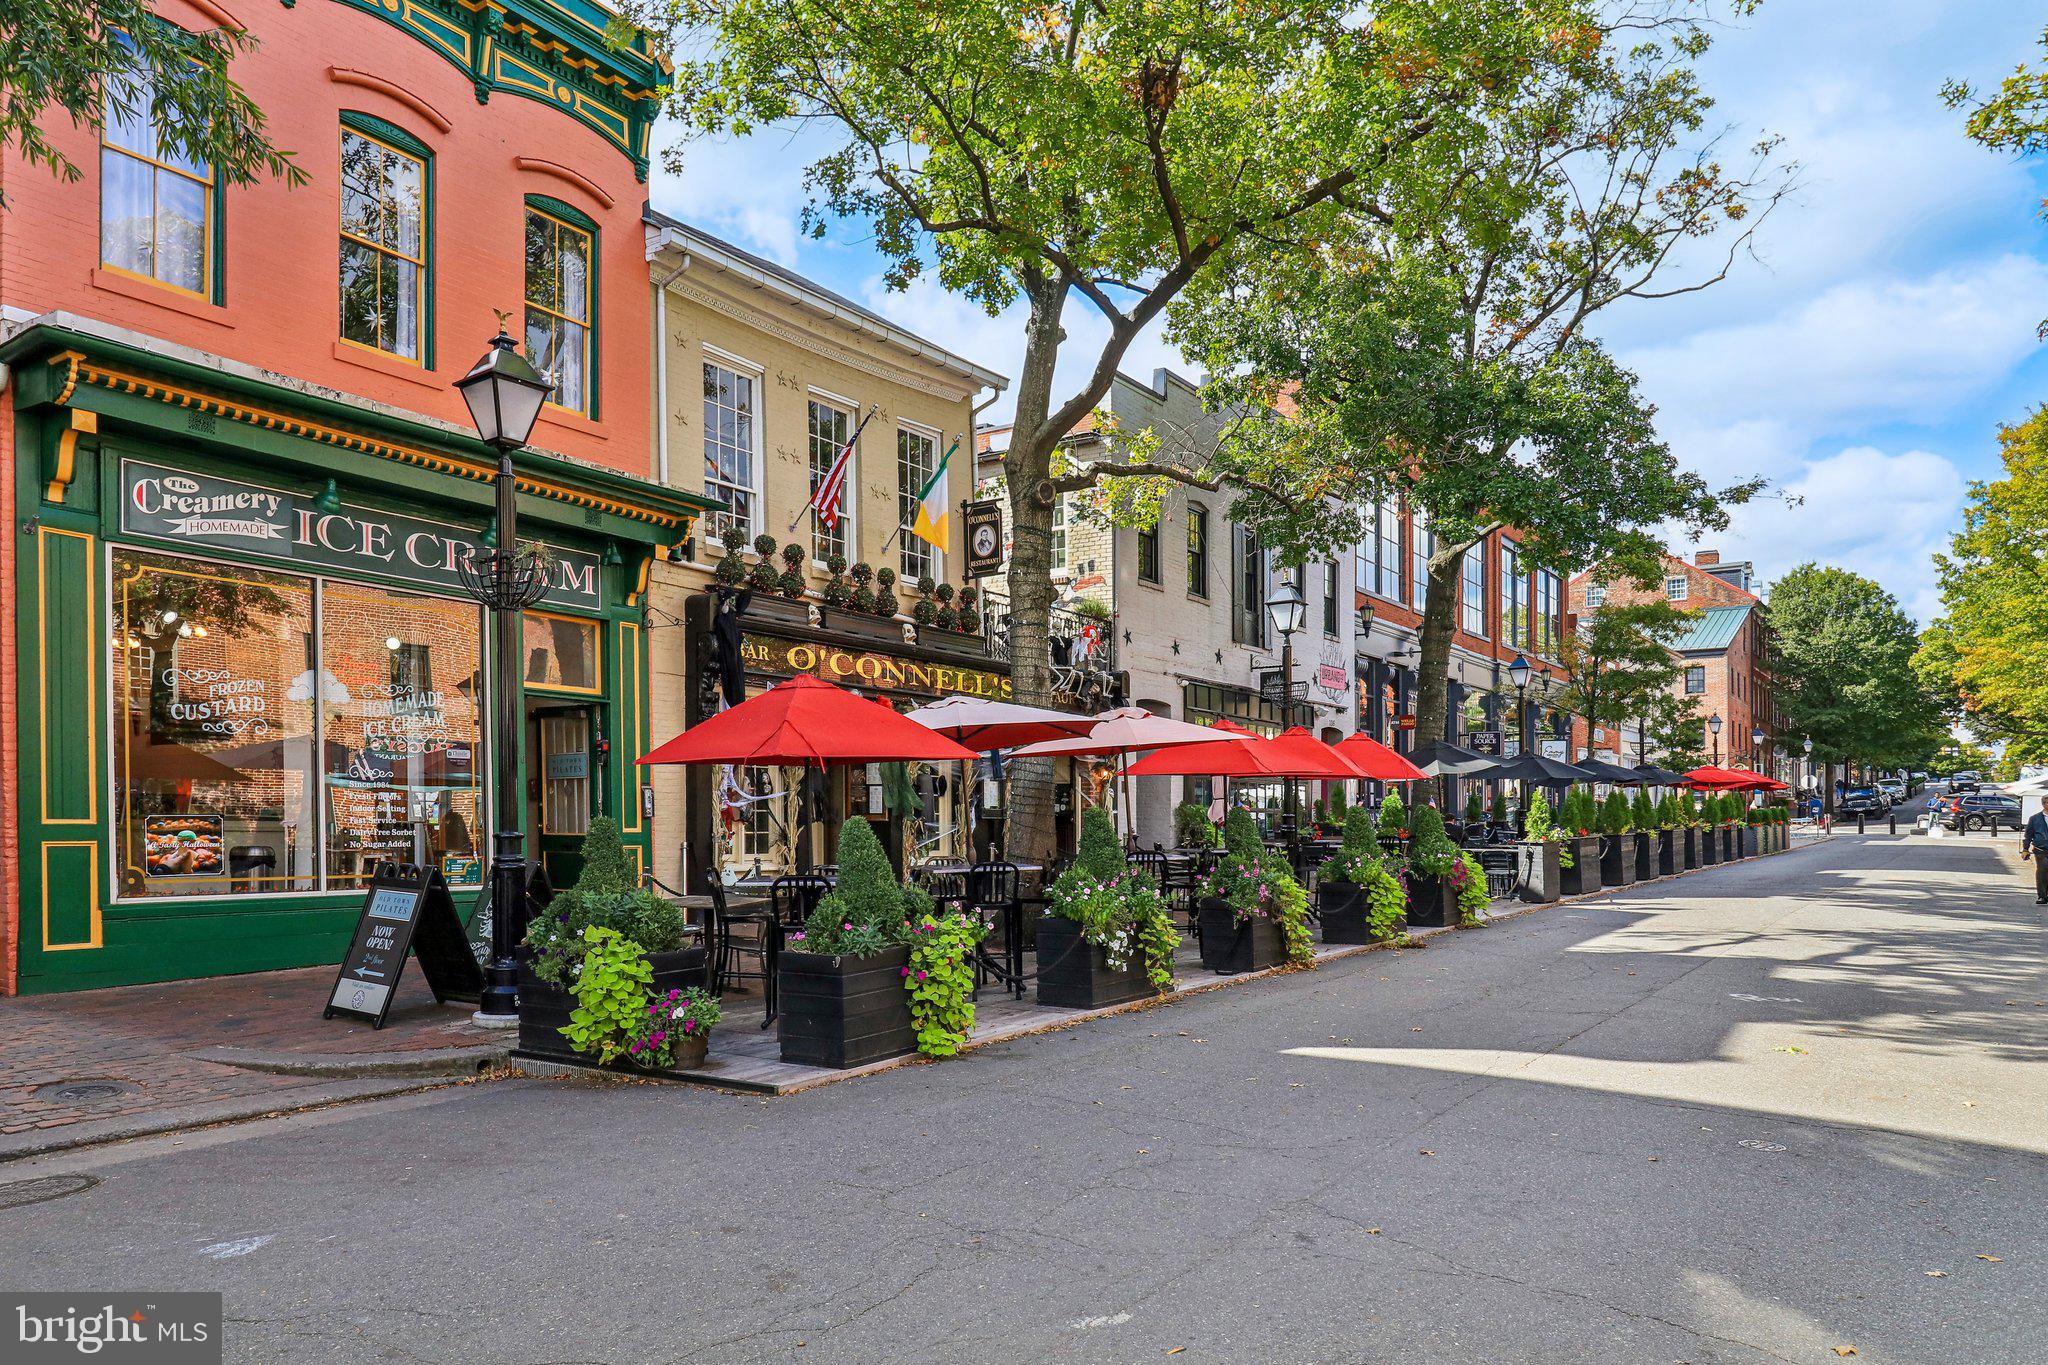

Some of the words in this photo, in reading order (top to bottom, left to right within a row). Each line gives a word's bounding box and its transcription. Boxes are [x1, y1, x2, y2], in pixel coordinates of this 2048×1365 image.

[168, 478, 196, 490] The
[132, 478, 282, 517] Creamery
[190, 521, 266, 535] HOMEMADE
[292, 508, 395, 562] ICE
[405, 532, 597, 596] CRAM
[787, 646, 1013, 699] O'CONNELL'S
[209, 680, 265, 697] FROZEN
[170, 696, 266, 720] CUSTARD
[363, 690, 445, 716] HOMEMADE
[363, 721, 387, 738] ICE
[391, 710, 446, 733] CREAM
[552, 765, 582, 774] PILATES
[377, 805, 406, 813] Seating
[391, 828, 417, 836] Sorbet
[182, 840, 221, 848] Halloween
[362, 841, 386, 849] Sugar
[387, 840, 411, 848] Added
[375, 903, 408, 915] PILATES
[371, 925, 396, 938] NOW
[366, 937, 394, 951] OPEN!
